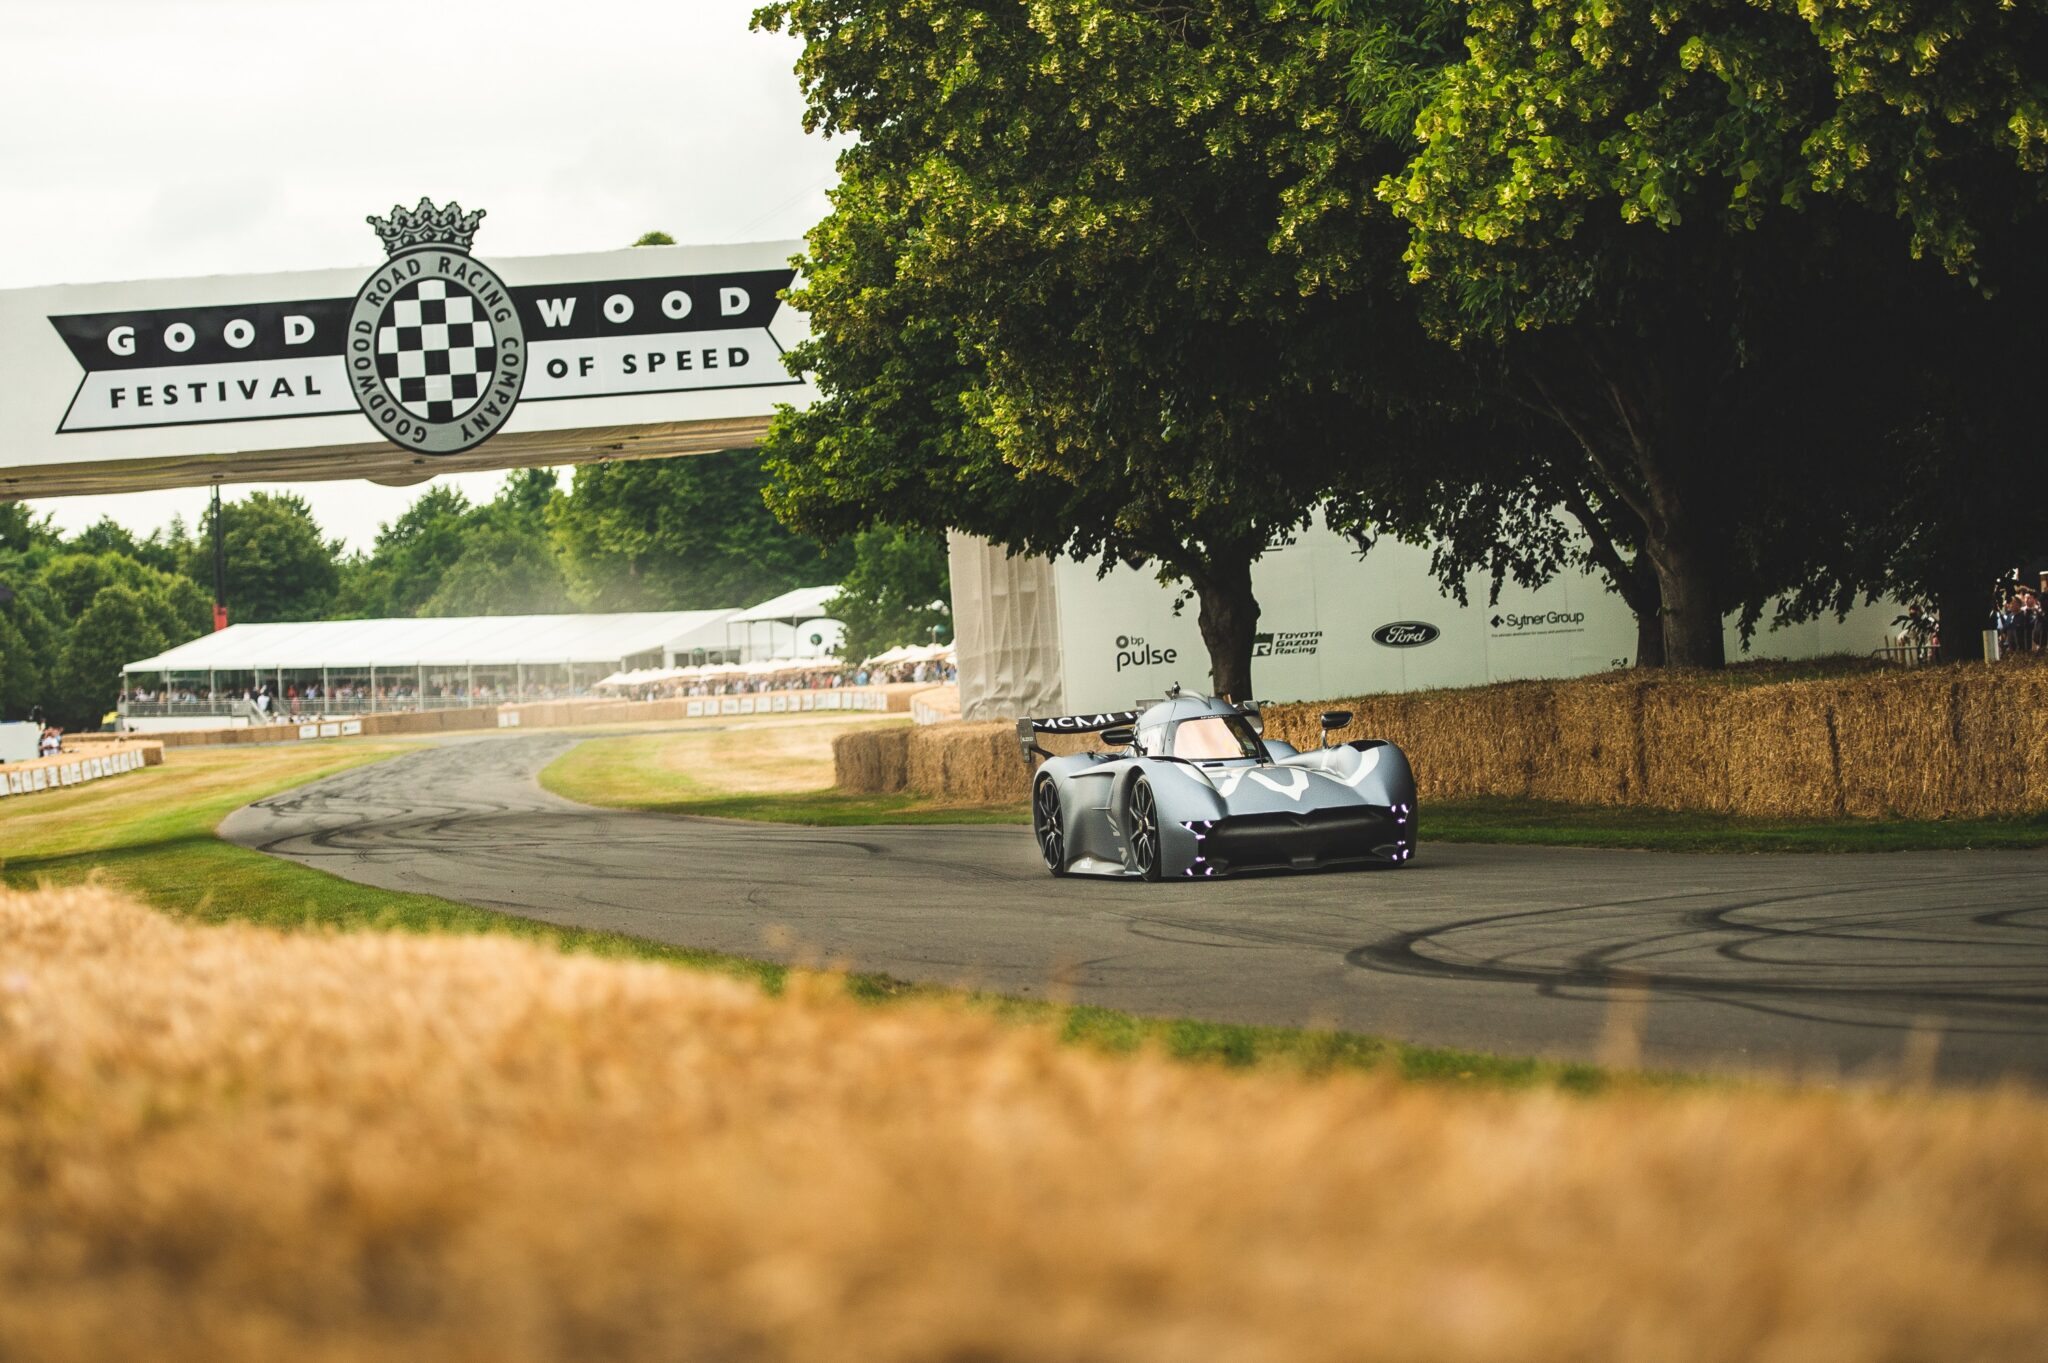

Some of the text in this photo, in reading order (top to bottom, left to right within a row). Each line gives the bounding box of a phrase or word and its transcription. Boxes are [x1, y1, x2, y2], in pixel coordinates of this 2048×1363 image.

[107, 287, 750, 356] GOOD WOOD
[353, 256, 520, 443] GOODWOOD ROAD RACING COMPANY
[110, 347, 750, 408] FESTIVAL OF SPEED
[1506, 611, 1585, 630] Sytner Group
[1130, 635, 1145, 647] bp
[1275, 638, 1319, 647] GAZOO
[1277, 631, 1323, 640] TOYOTA
[1386, 626, 1426, 643] Ford
[1116, 643, 1177, 672] pulse
[1274, 646, 1317, 655] Racing
